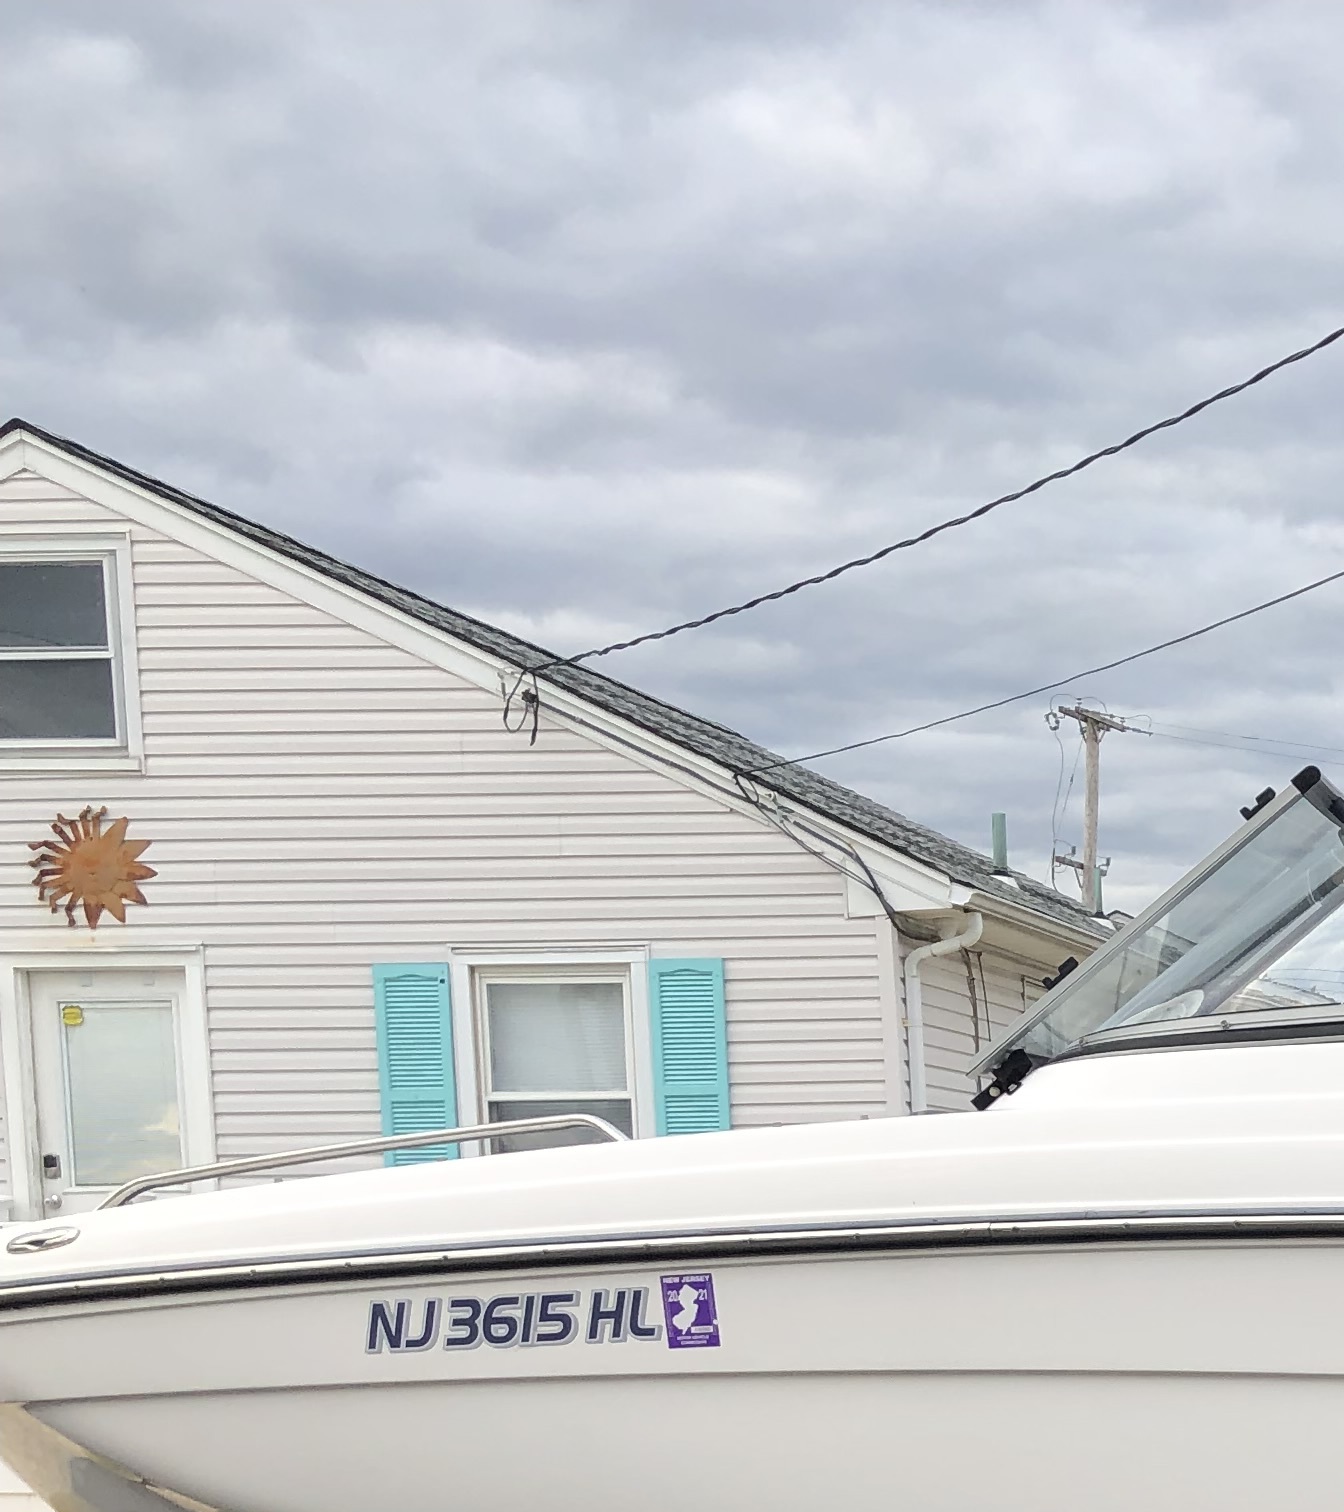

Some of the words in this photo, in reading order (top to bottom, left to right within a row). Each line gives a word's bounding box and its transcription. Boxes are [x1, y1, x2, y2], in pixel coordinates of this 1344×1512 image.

[681, 1274, 710, 1283] JERSEY
[365, 1297, 443, 1354] NJ
[443, 1289, 580, 1350] 3615
[586, 1286, 664, 1344] HL
